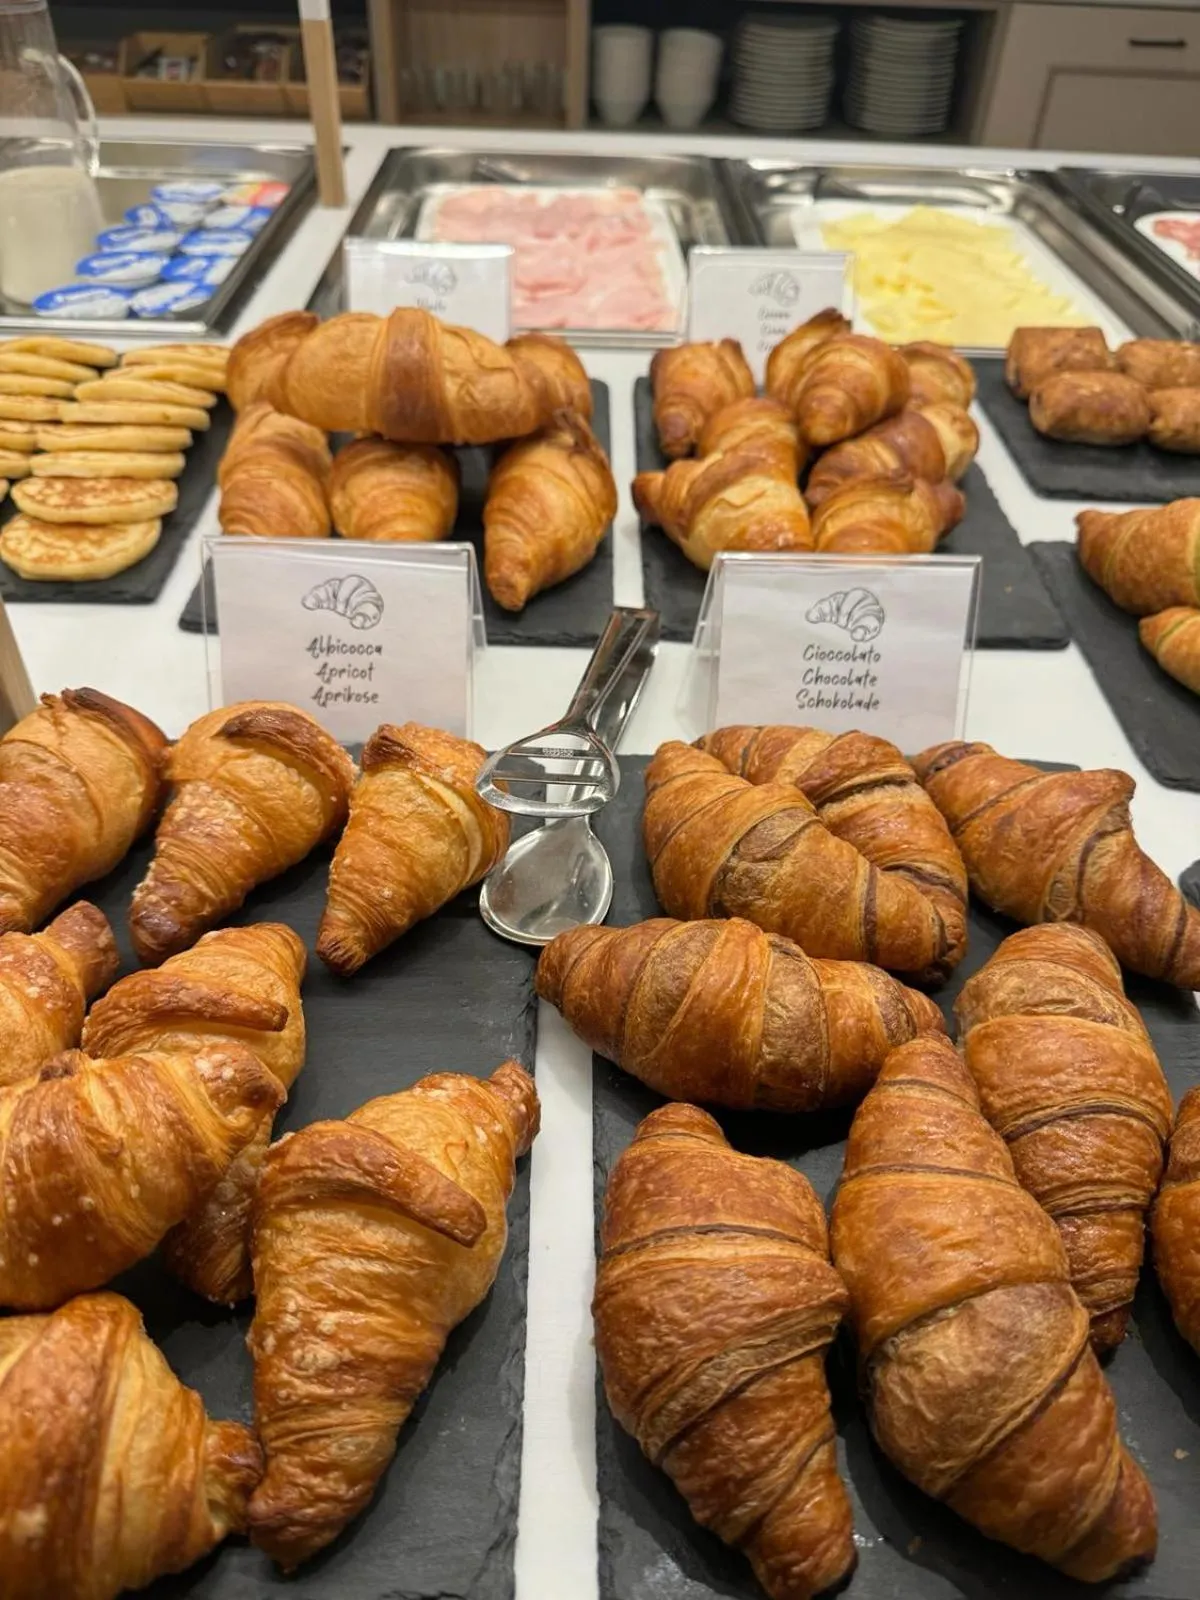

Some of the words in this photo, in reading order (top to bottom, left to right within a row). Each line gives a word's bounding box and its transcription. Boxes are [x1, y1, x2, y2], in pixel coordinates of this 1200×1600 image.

[306, 634, 382, 658] Albicocca
[802, 644, 882, 663] Cioccolato
[315, 661, 376, 684] Apricot
[802, 667, 878, 687] Chocolate
[311, 686, 379, 708] Aprikose
[795, 688, 880, 711] Schokolade
